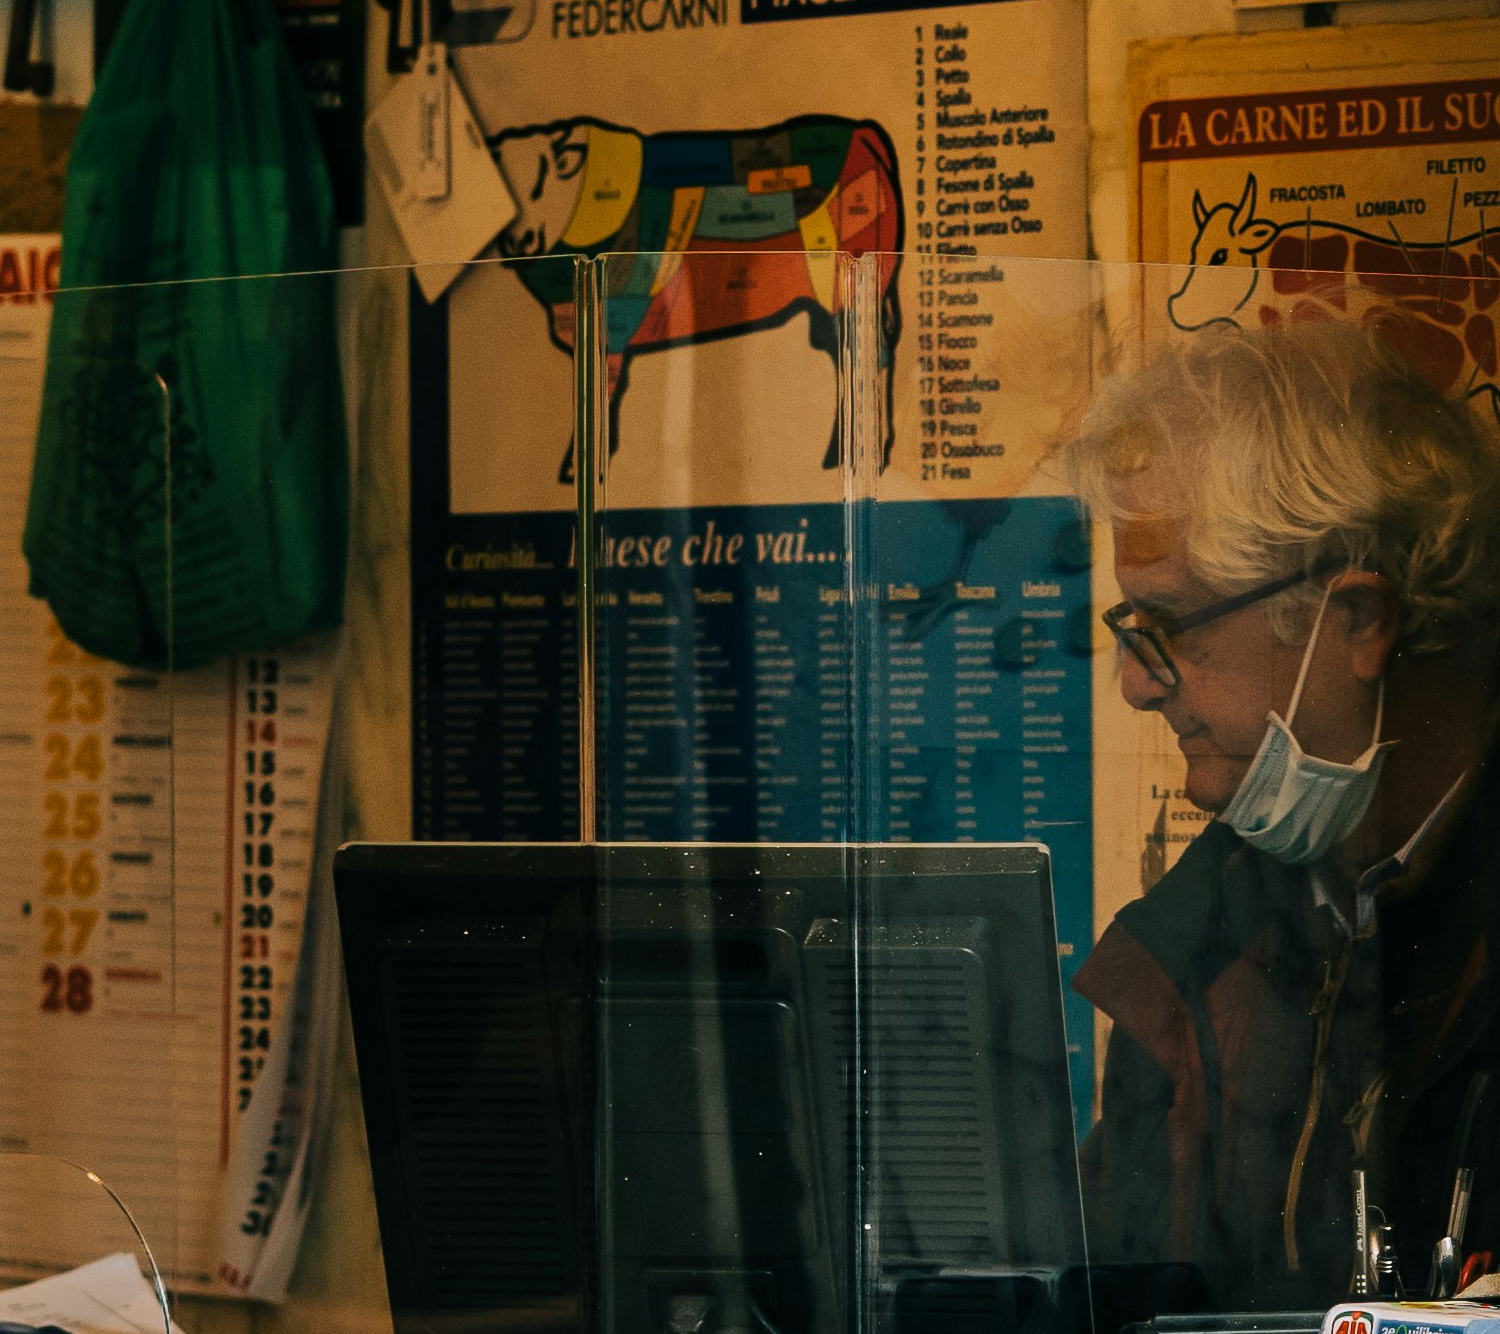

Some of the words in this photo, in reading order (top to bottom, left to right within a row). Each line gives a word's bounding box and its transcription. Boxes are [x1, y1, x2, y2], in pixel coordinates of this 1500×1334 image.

[1148, 110, 1197, 151] LA
[1204, 101, 1329, 148] CARNE
[1338, 98, 1388, 138] ED
[1396, 95, 1436, 135] IL
[1426, 156, 1487, 176] FILETTO
[1269, 184, 1346, 204] FRACOSTA
[1355, 198, 1427, 219] LOMBATO
[680, 519, 744, 566] che
[43, 674, 105, 724] 23
[43, 732, 106, 782] 24
[42, 790, 101, 840] 25
[42, 849, 100, 898] 26
[41, 907, 100, 957] 27
[40, 963, 94, 1014] 28
